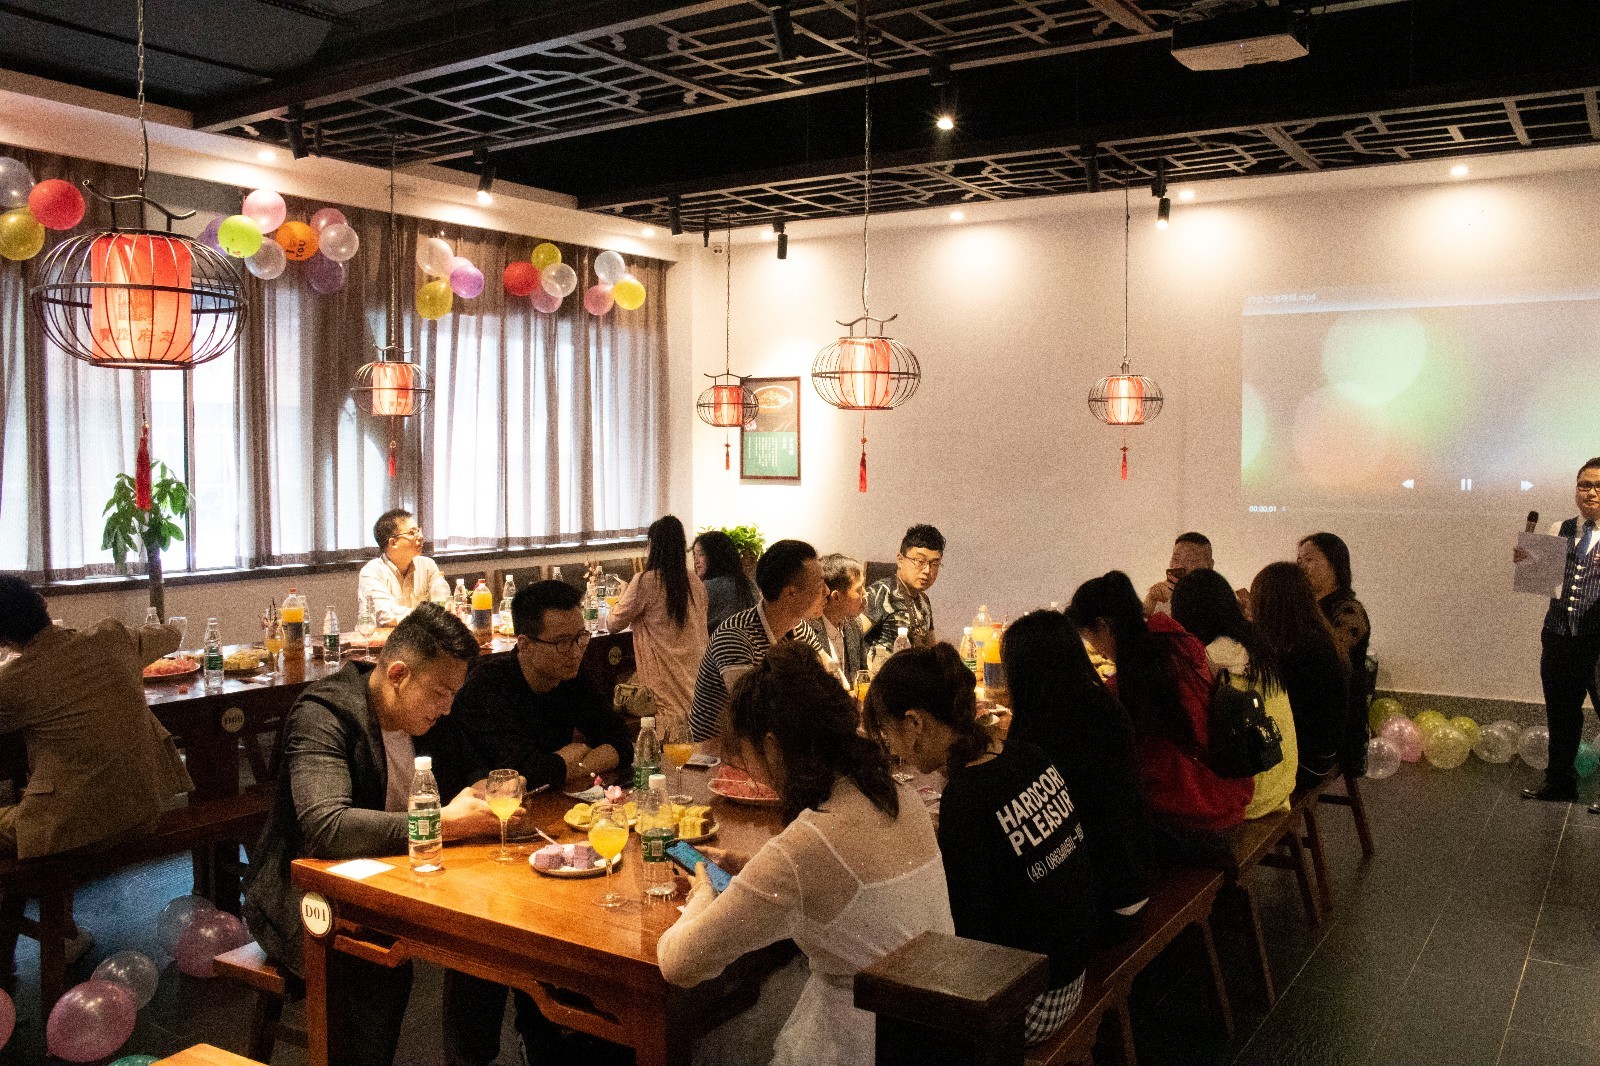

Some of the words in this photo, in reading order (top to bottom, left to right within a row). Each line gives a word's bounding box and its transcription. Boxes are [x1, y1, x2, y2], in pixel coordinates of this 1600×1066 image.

[1008, 787, 1075, 857] PLEASUR
[1026, 860, 1048, 883] (48)
[305, 904, 326, 922] D01
